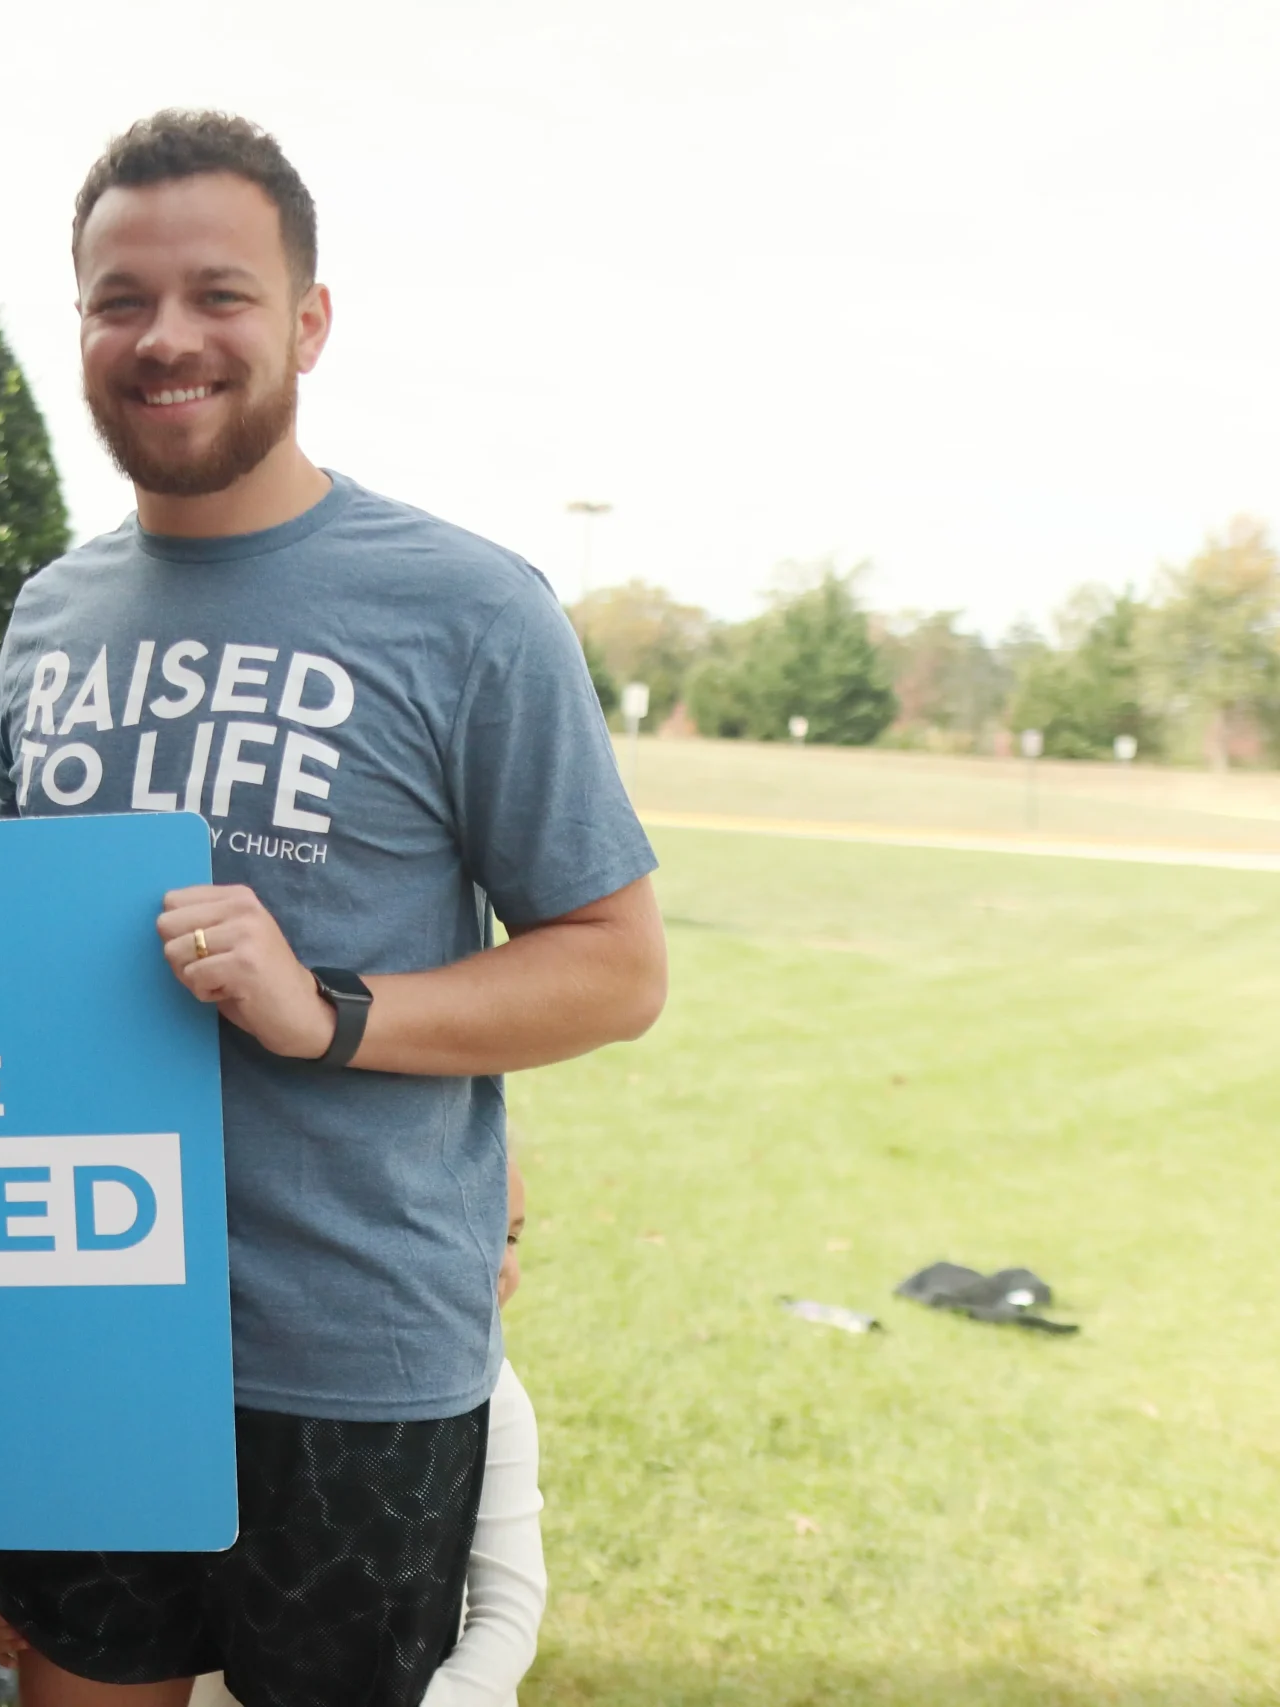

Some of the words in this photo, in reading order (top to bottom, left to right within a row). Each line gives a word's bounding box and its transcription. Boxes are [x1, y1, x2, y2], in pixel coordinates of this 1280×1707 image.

[24, 639, 355, 736] RAISED
[19, 737, 103, 806] TO
[131, 720, 340, 834] LIFE
[229, 830, 328, 865] CHURCH
